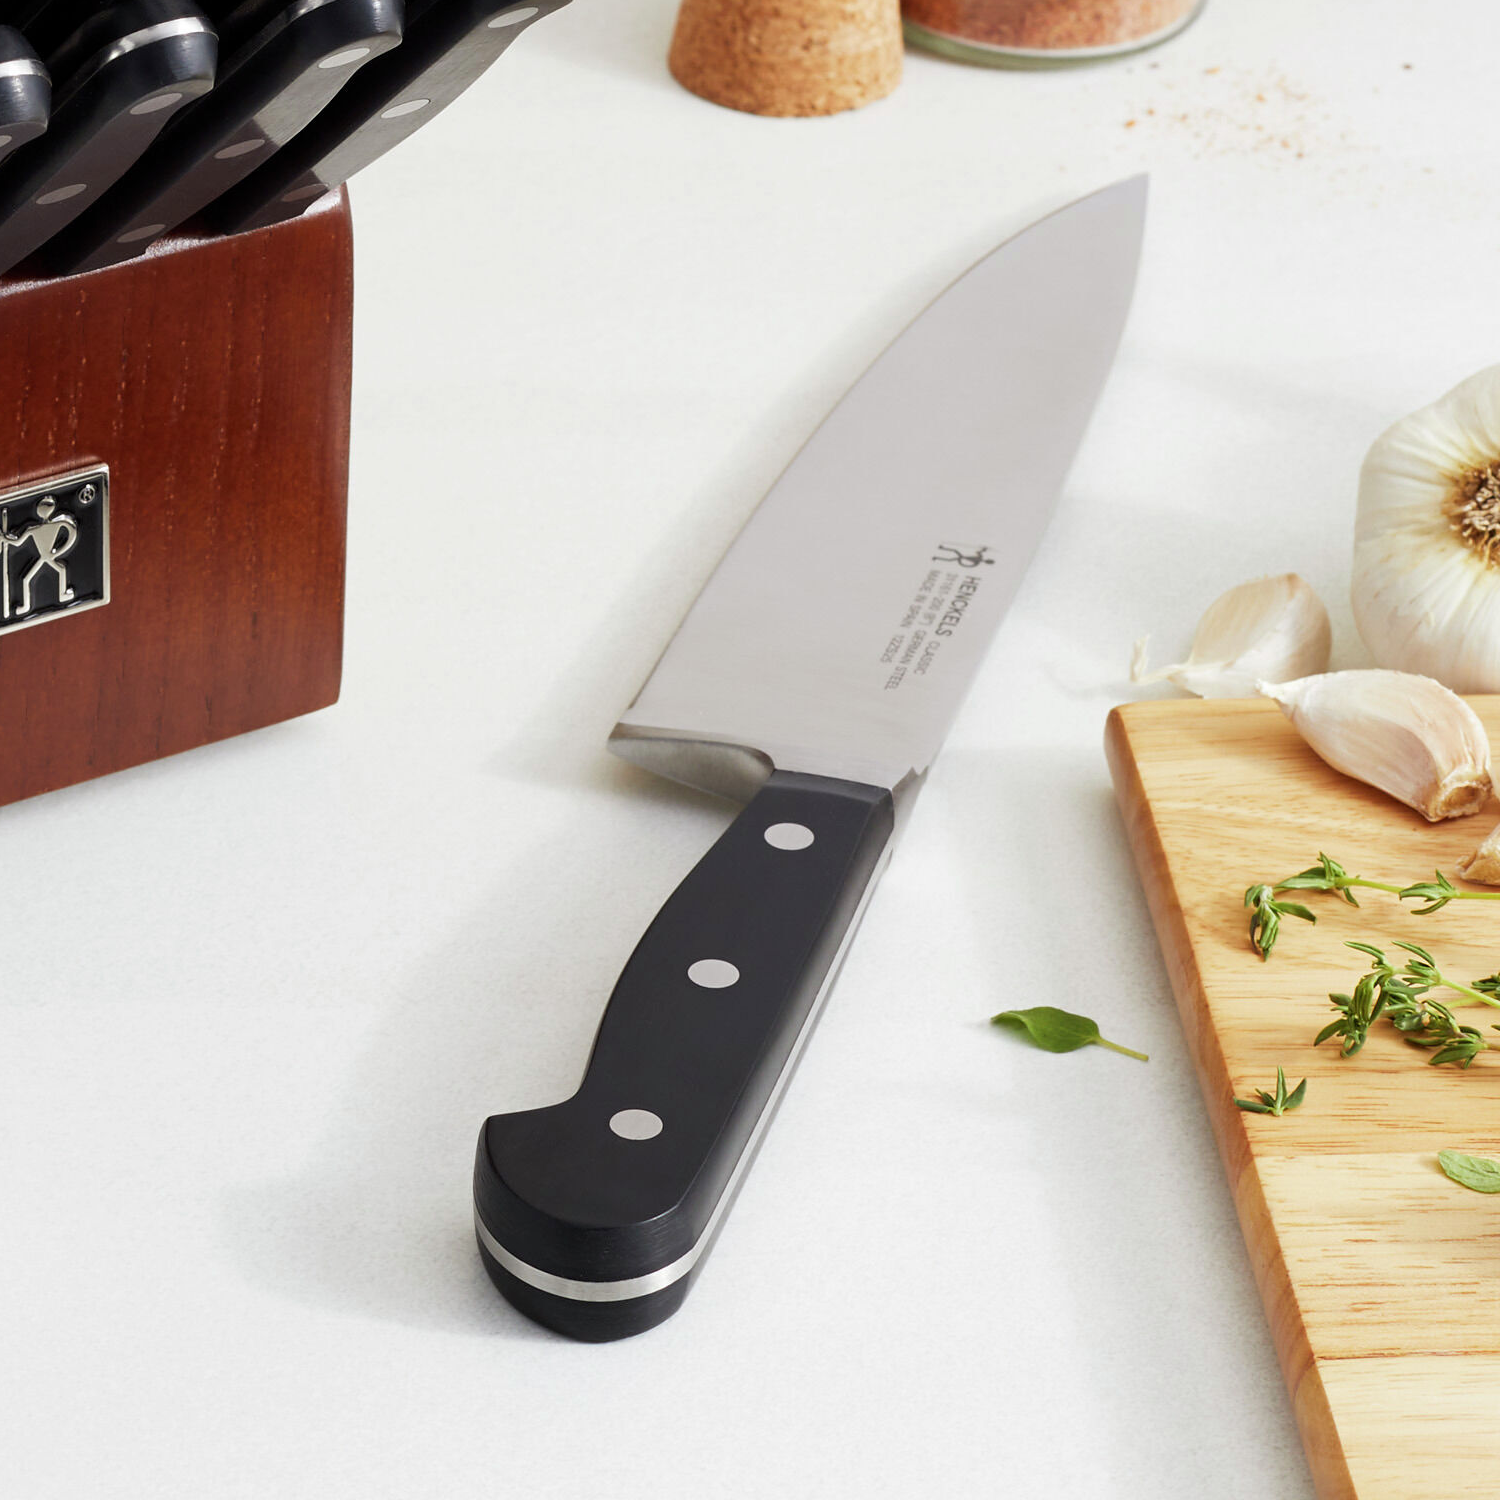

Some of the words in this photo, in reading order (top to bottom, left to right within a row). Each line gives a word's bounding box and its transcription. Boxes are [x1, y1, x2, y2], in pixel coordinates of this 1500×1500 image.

[919, 570, 940, 593] MADE
[914, 594, 927, 603] IN
[934, 575, 981, 637] HENCKELS
[900, 604, 921, 628] SPAIN
[900, 629, 927, 665] GERMAN
[913, 640, 940, 675] CLASSIC
[884, 666, 907, 690] STEEL
